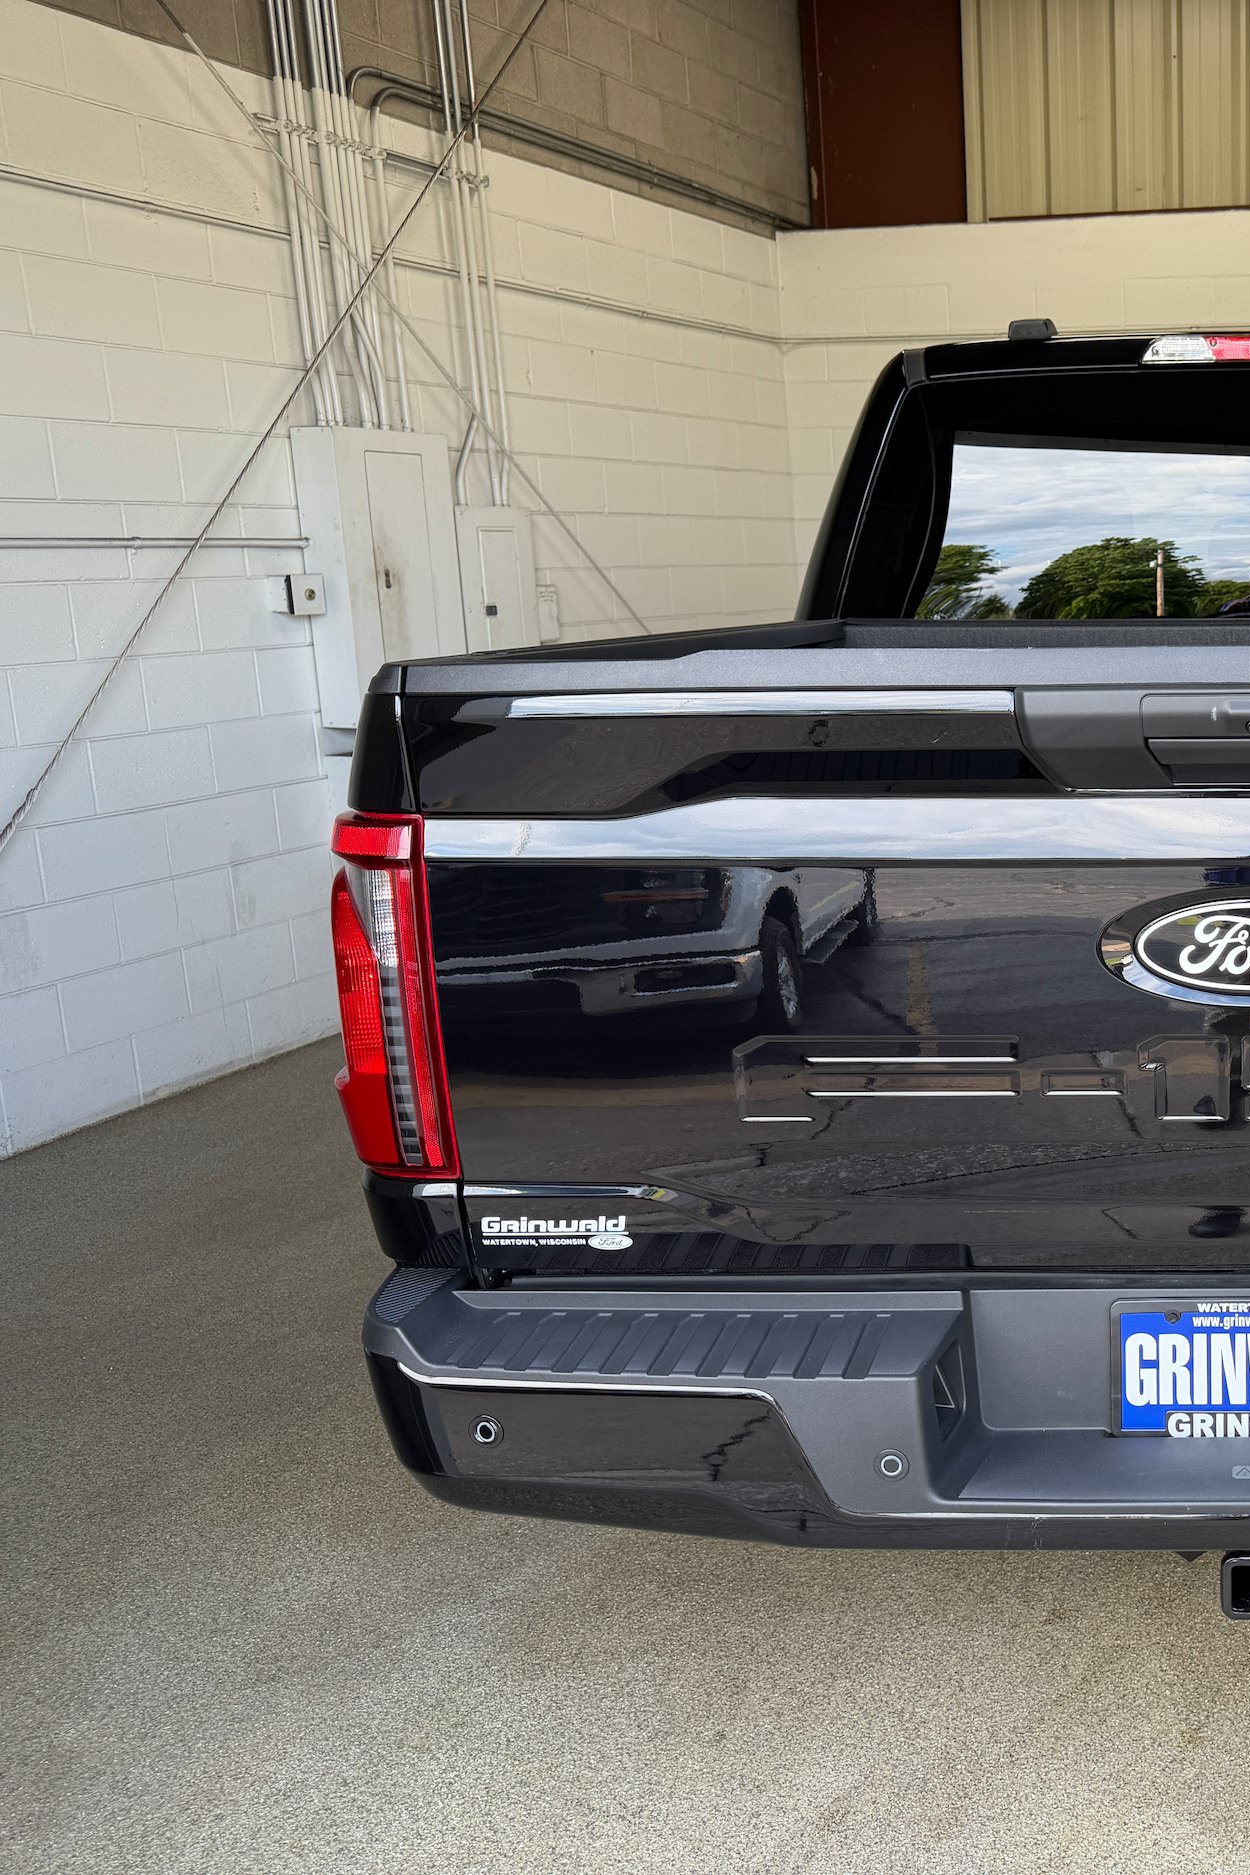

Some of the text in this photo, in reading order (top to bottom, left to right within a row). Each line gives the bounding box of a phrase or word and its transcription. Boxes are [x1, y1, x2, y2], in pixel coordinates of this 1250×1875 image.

[481, 1216, 626, 1233] Grinwald
[482, 1238, 586, 1247] WATERTOWN, WISCONSIN
